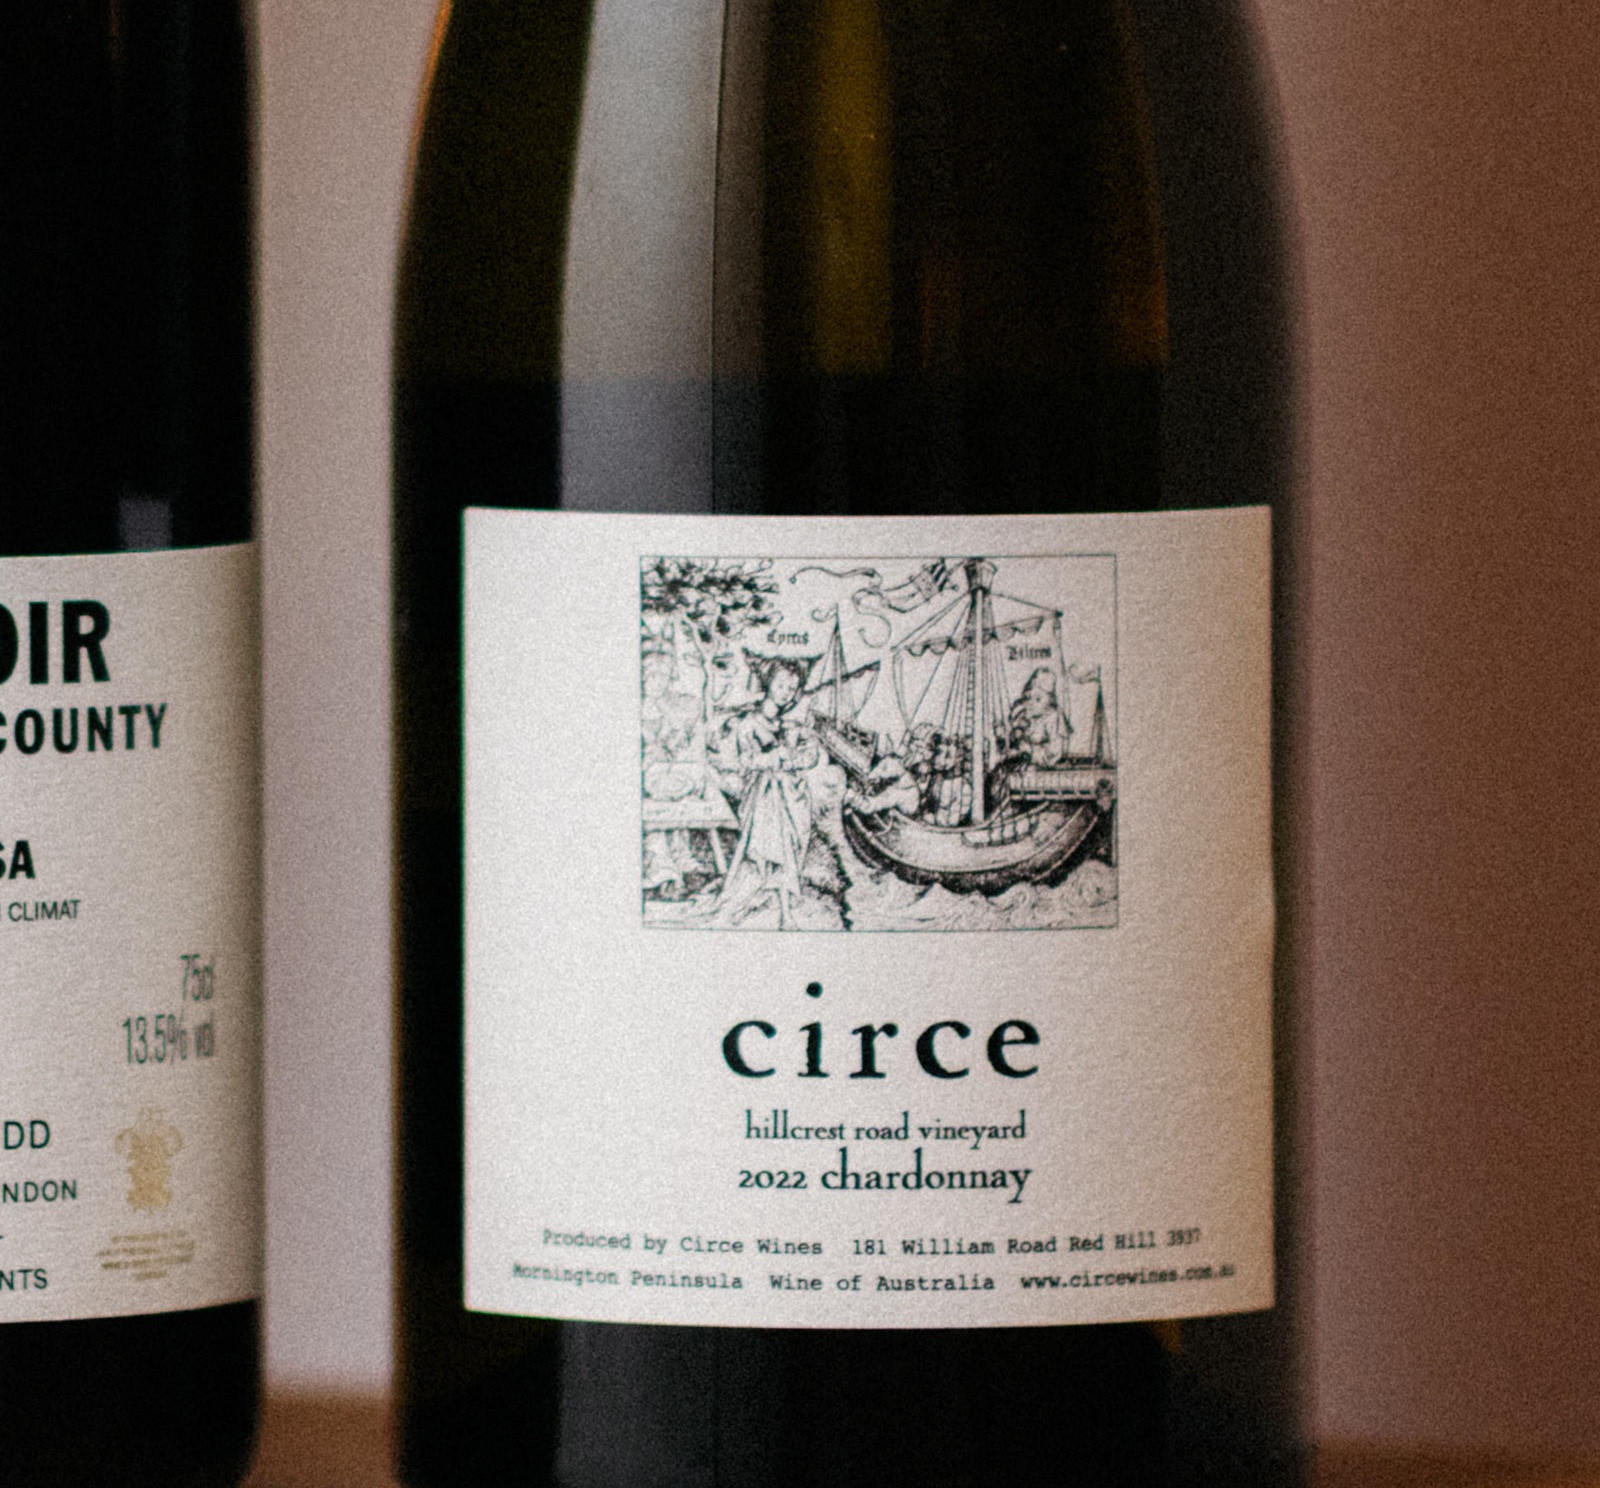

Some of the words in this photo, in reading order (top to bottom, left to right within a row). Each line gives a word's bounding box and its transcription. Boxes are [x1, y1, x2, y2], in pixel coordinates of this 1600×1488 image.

[8, 899, 80, 922] CLIMAT
[721, 982, 1040, 1079] circe
[746, 1109, 845, 1140] hillcrest
[855, 1111, 908, 1140] road
[918, 1109, 1026, 1149] vineyard
[739, 1170, 807, 1189] 2022
[821, 1147, 1031, 1204] chardonnay
[543, 1229, 631, 1250] Produced
[643, 1235, 667, 1255] by
[680, 1237, 744, 1253] Circe
[757, 1240, 822, 1254] Wines
[855, 1240, 885, 1255] 181
[902, 1239, 994, 1255] William
[1008, 1238, 1056, 1253] Road
[1070, 1237, 1102, 1251] Red
[1115, 1232, 1155, 1249] Hill
[512, 1263, 618, 1287] Mornington
[631, 1271, 743, 1289] Peninsula
[770, 1276, 822, 1290] Wine
[836, 1275, 860, 1291] of
[877, 1274, 995, 1291] Australia
